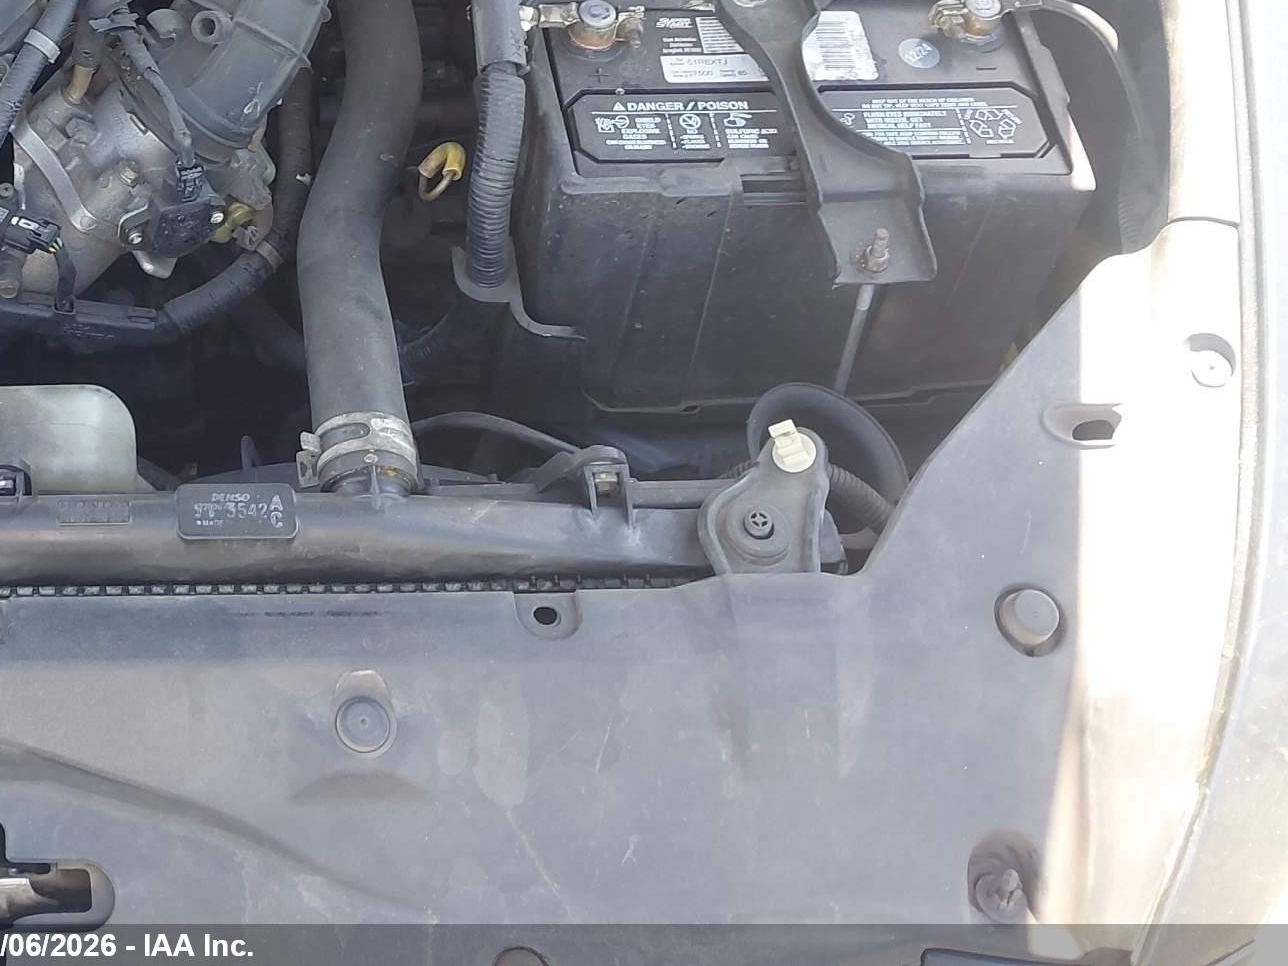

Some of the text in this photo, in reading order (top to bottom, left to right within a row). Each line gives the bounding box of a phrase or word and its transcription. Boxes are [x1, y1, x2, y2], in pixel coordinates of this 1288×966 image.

[904, 42, 934, 63] 12/24
[627, 101, 749, 111] DANGER / POISON
[211, 493, 251, 502] DENSO
